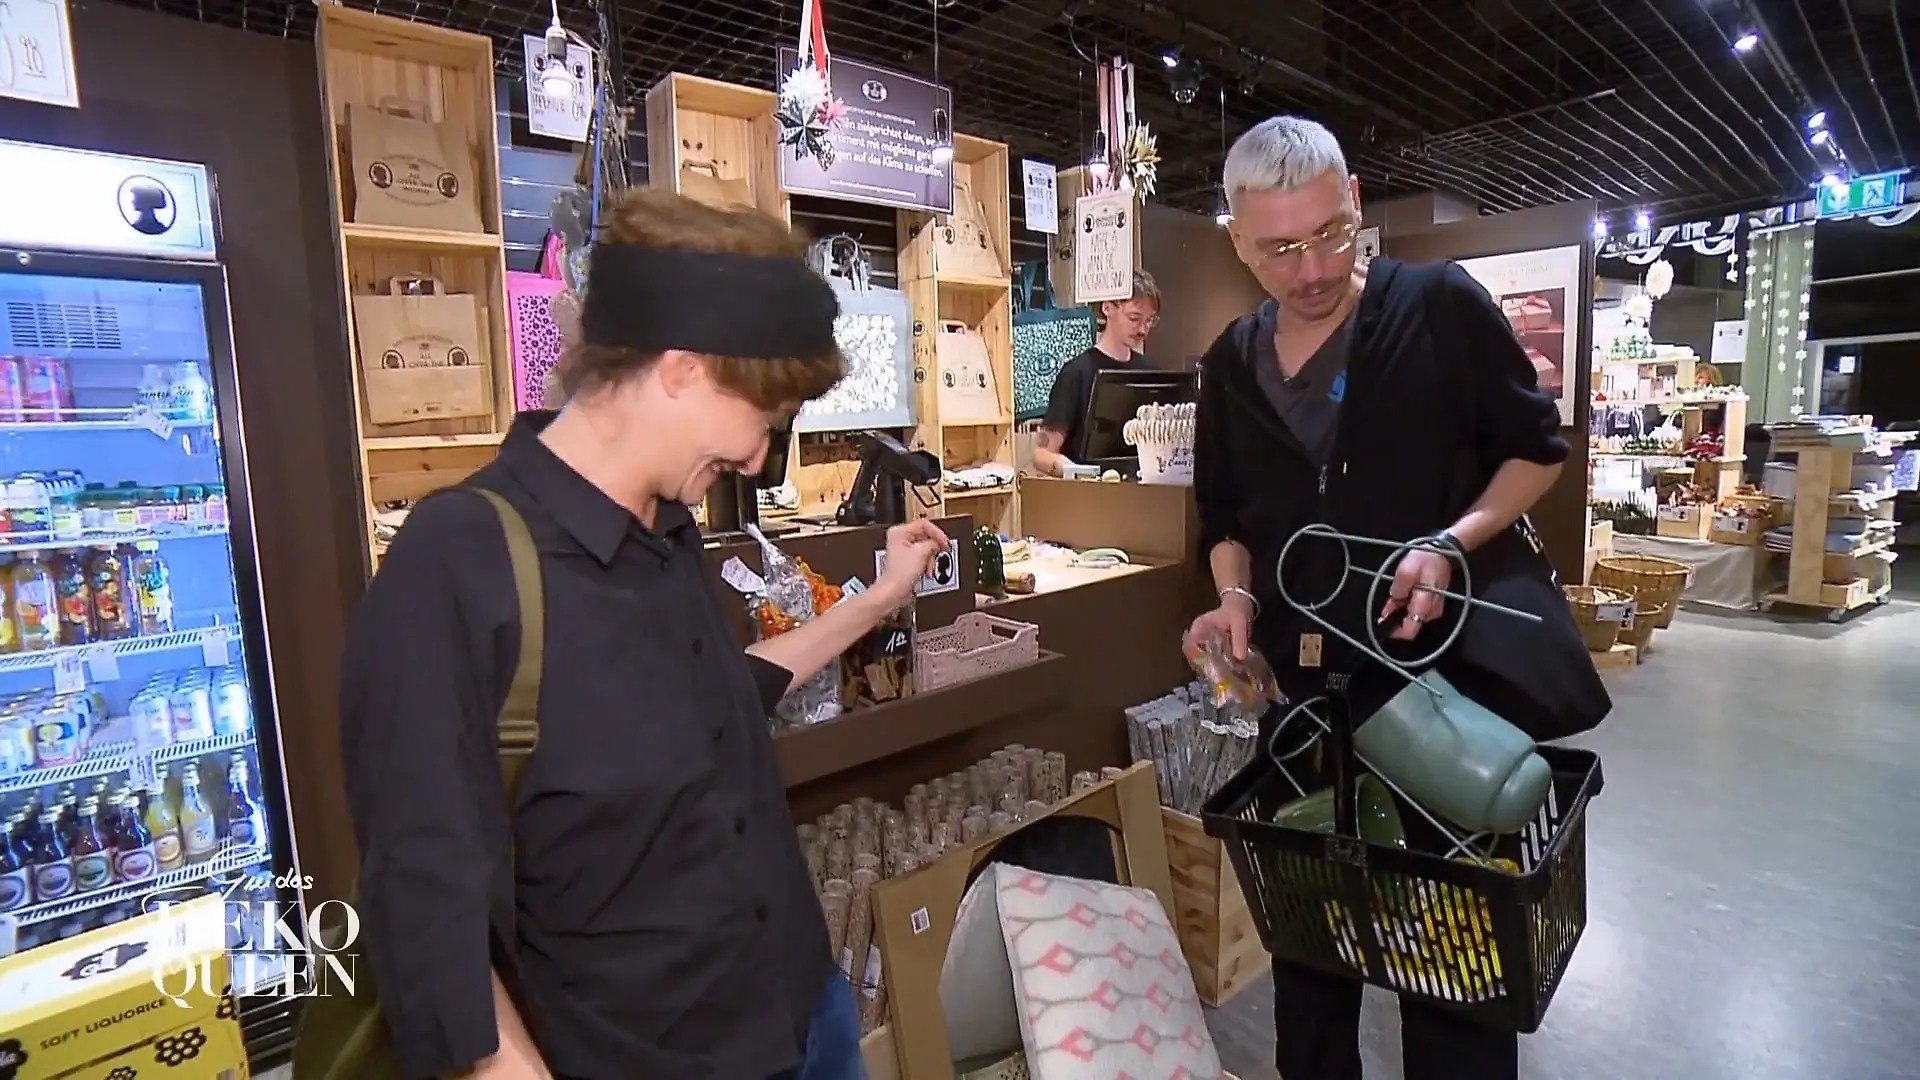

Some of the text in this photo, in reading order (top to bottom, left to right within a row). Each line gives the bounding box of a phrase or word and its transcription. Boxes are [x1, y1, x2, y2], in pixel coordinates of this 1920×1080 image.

[866, 137, 881, 150] mit
[880, 140, 917, 158] möglichst
[882, 154, 904, 170] Klima
[40, 997, 168, 1051] SOFT LIQUORICE
